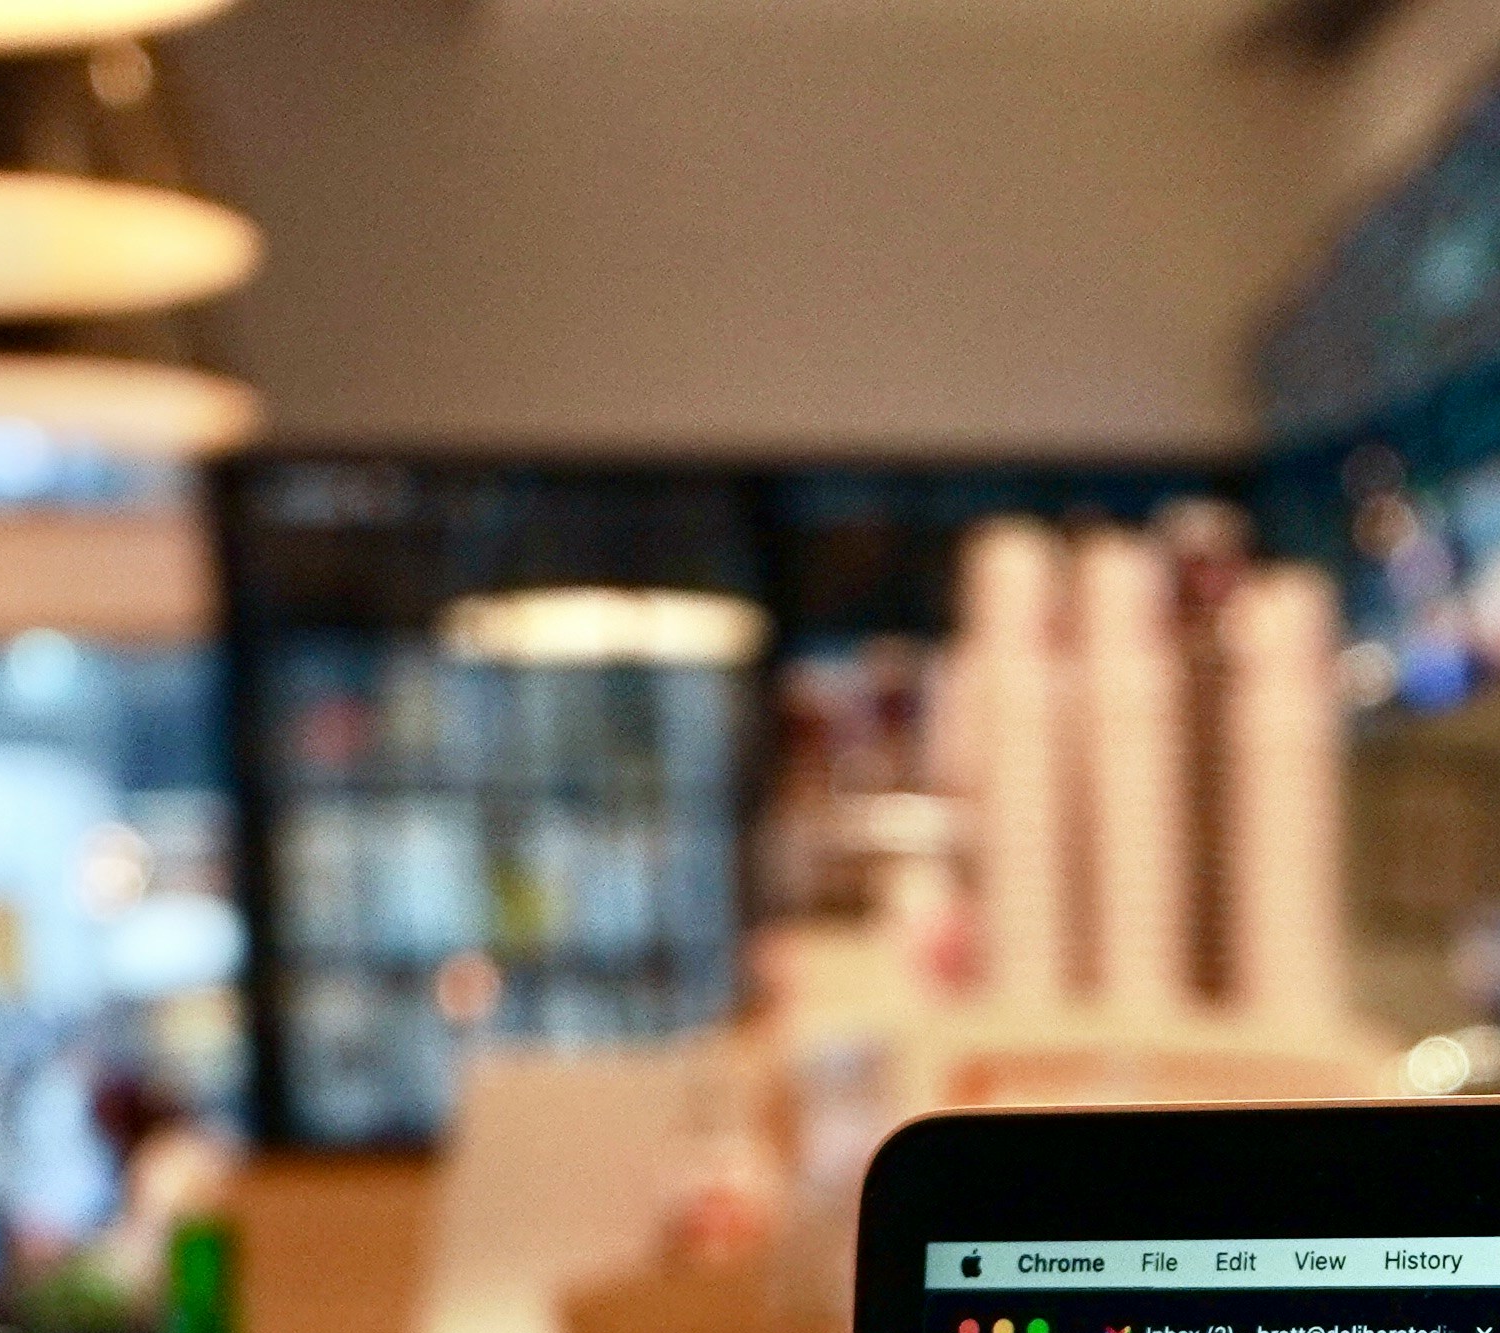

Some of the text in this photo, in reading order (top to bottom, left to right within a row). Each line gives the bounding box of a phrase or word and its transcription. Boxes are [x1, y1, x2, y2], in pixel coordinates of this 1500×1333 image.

[1017, 1252, 1106, 1274] Chrome
[1141, 1251, 1179, 1272] File
[1215, 1251, 1258, 1272] Edit
[1294, 1250, 1347, 1271] View
[1384, 1249, 1464, 1275] History
